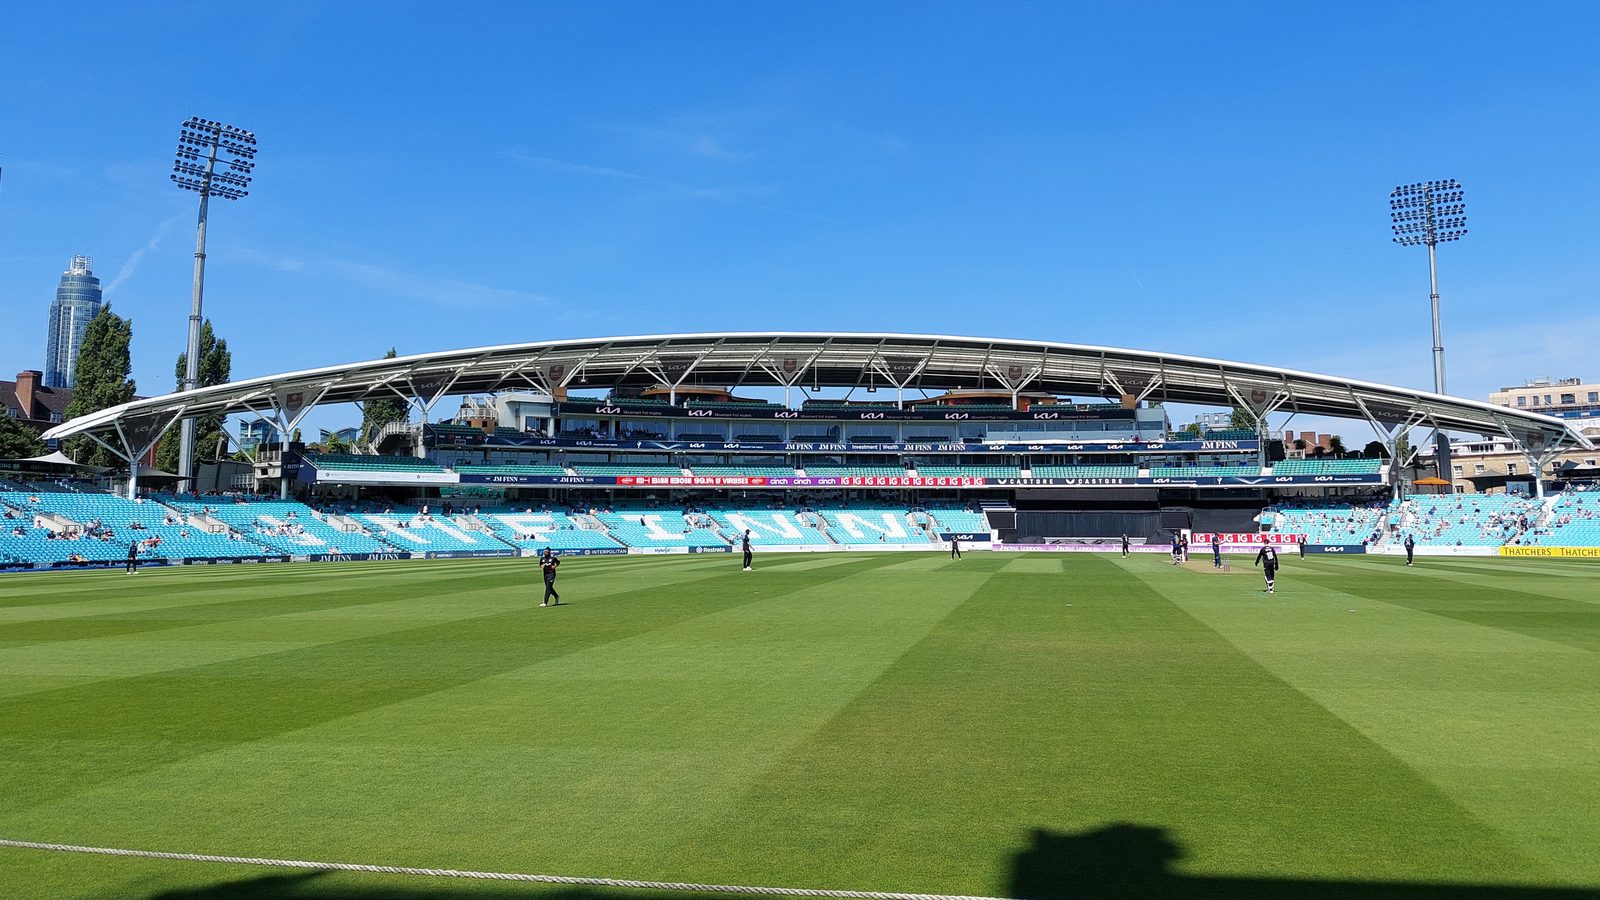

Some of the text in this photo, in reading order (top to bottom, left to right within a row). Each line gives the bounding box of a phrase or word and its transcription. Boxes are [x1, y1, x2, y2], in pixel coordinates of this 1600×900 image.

[596, 406, 620, 414] KIA
[1201, 441, 1238, 449] JM FINN
[1196, 534, 1205, 542] IG
[1238, 534, 1248, 542] IG
[1252, 534, 1262, 542] IG
[1503, 547, 1551, 555] THATCHERS
[1560, 548, 1600, 556] THATCHE
